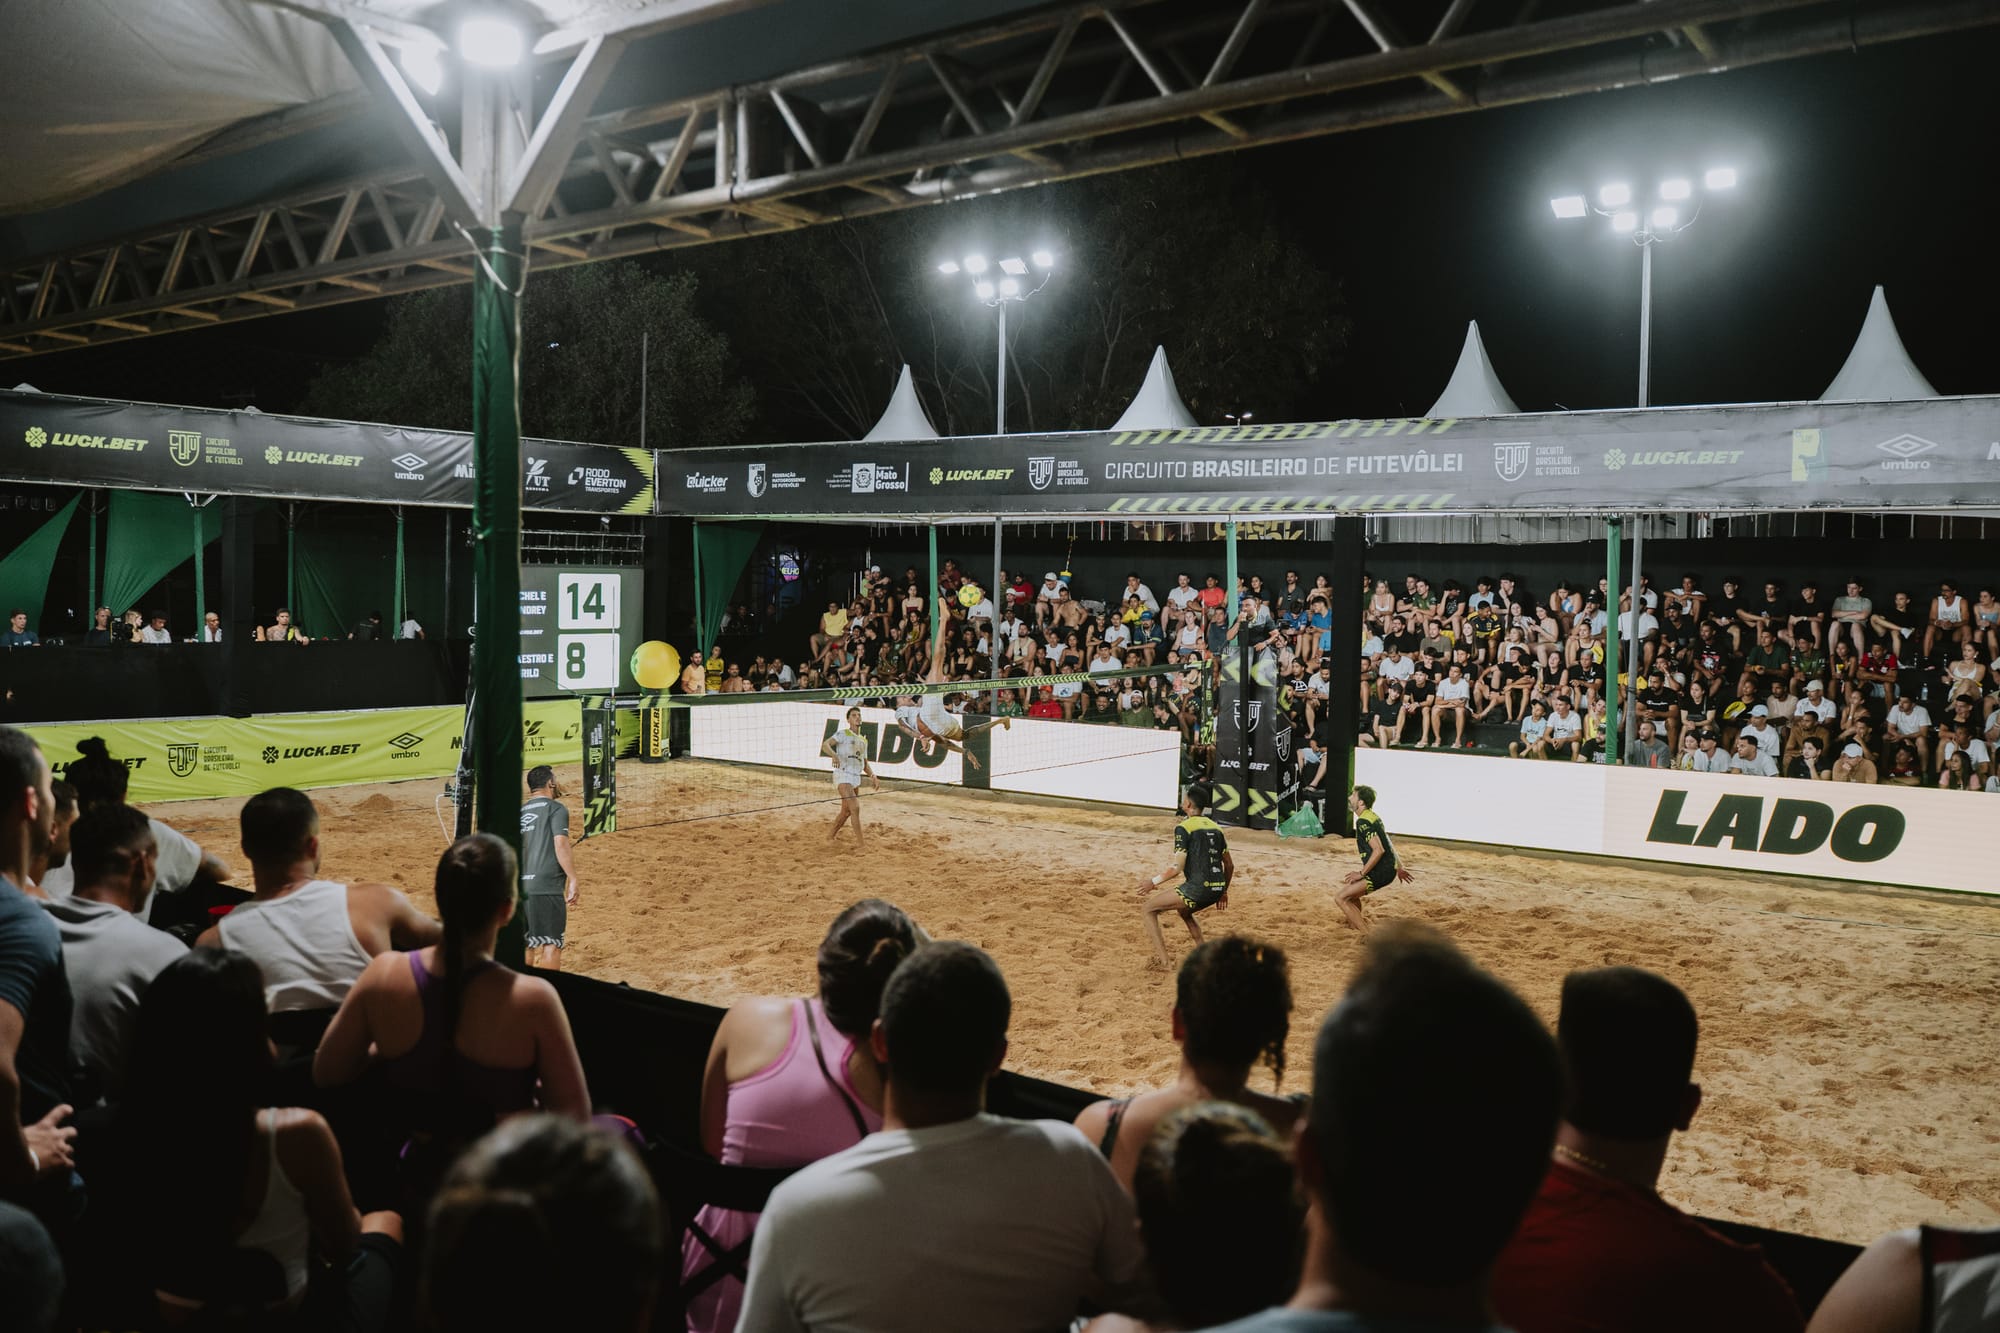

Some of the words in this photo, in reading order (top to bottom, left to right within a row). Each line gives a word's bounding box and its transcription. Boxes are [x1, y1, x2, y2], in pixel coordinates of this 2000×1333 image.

[51, 432, 149, 452] LUCK.BET
[286, 451, 364, 467] LUCK.BET
[1632, 450, 1744, 466] LUCK.BET
[1105, 461, 1187, 480] CIRCUITO
[1192, 457, 1308, 478] BRASILEIRO
[1314, 457, 1340, 475] DE
[1346, 450, 1464, 474] FUTEVÔLEI
[1881, 459, 1931, 470] umbro
[394, 471, 425, 480] umbro
[686, 472, 728, 489] Quicker
[875, 470, 898, 480] Mato
[946, 468, 1015, 481] LUCK.BET
[585, 477, 627, 489] EVERTON
[875, 480, 906, 490] Grosso
[519, 591, 541, 601] CHEL
[566, 582, 606, 620] 14
[519, 605, 547, 615] NDREY
[517, 654, 547, 664] AESTRO
[566, 642, 586, 679] 8
[520, 668, 540, 678] RILO
[283, 744, 361, 759] LUCK.BET
[391, 750, 420, 760] umbro
[1220, 759, 1270, 771] LUCBET
[1646, 789, 1906, 863] LADO
